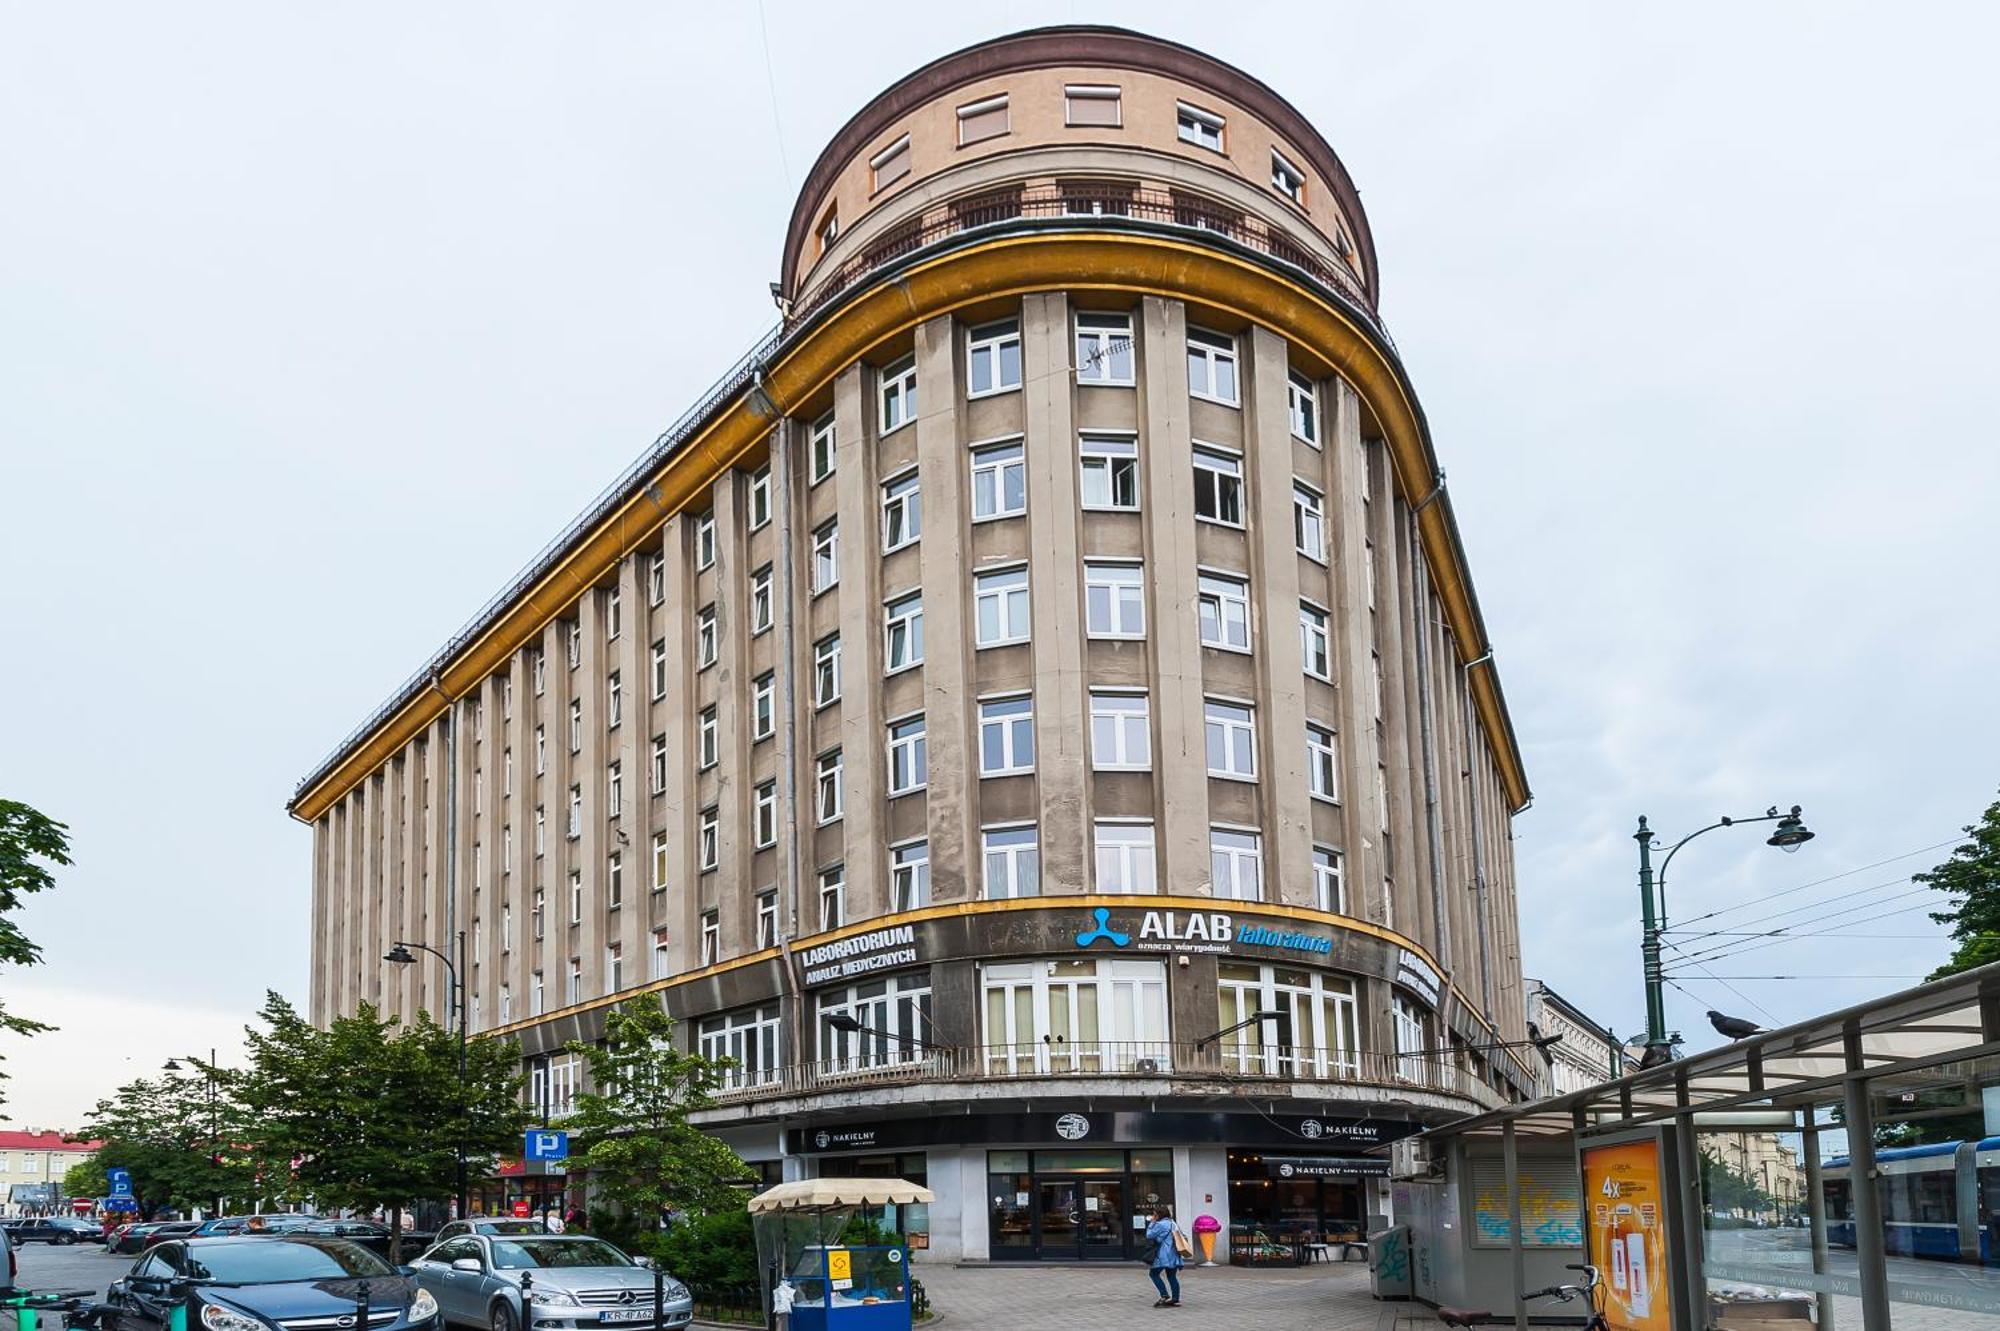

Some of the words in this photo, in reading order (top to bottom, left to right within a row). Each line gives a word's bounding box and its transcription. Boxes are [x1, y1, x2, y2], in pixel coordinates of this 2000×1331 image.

[1139, 911, 1232, 942] ALAB
[802, 925, 914, 968] LABORATORIUM
[1138, 943, 1172, 951] oznacza
[1236, 924, 1334, 954] laboratoria
[806, 964, 842, 984] ANALIZ
[842, 949, 917, 976] MEDYCZNYCH
[833, 1131, 875, 1142] NAKIELNY
[1326, 1126, 1377, 1135] NAKIELNY
[535, 1133, 558, 1156] P
[1296, 1167, 1341, 1175] NAKIELNY
[115, 1183, 128, 1193] P
